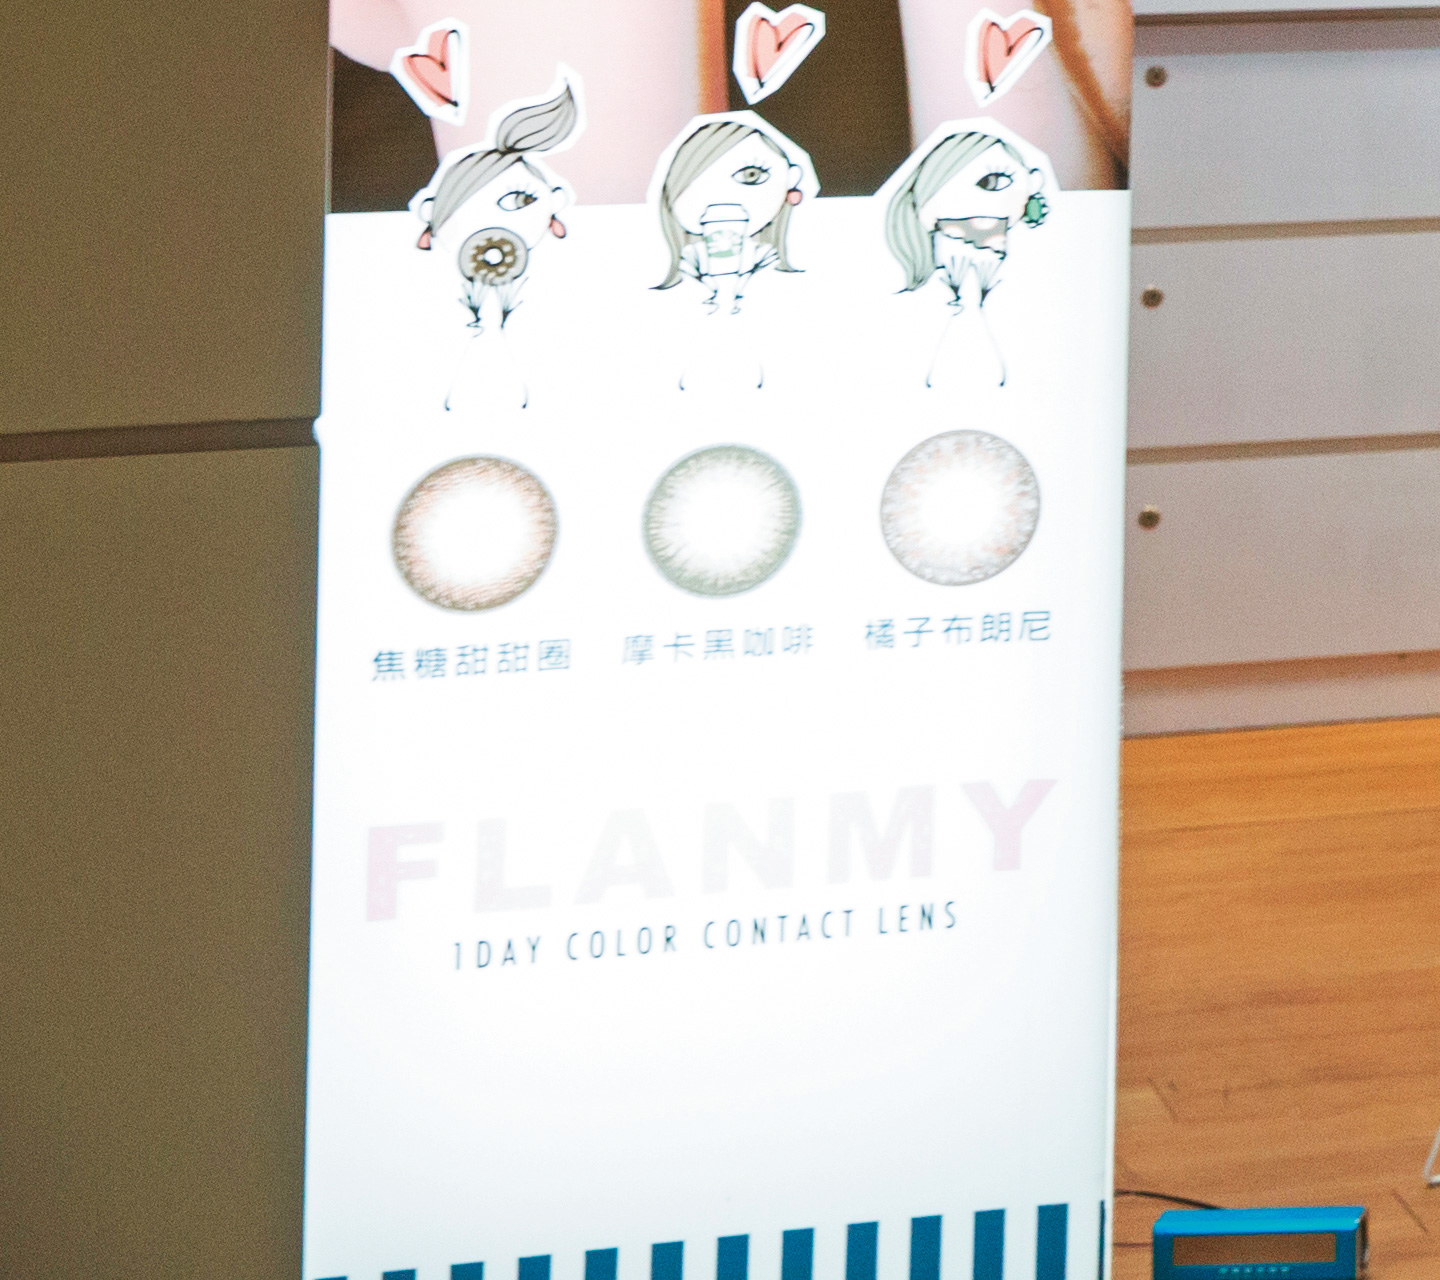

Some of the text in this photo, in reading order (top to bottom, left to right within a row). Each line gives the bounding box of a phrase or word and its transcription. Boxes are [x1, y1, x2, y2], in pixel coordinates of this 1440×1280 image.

[621, 623, 816, 667] 摩卡黑咖啡
[861, 609, 1053, 651] 橘子布朗尼
[370, 638, 573, 684] 焦糖甜甜圈
[364, 776, 1060, 924] FLANMY
[453, 899, 960, 972] 1DAY COLOR CONTACT LENS
